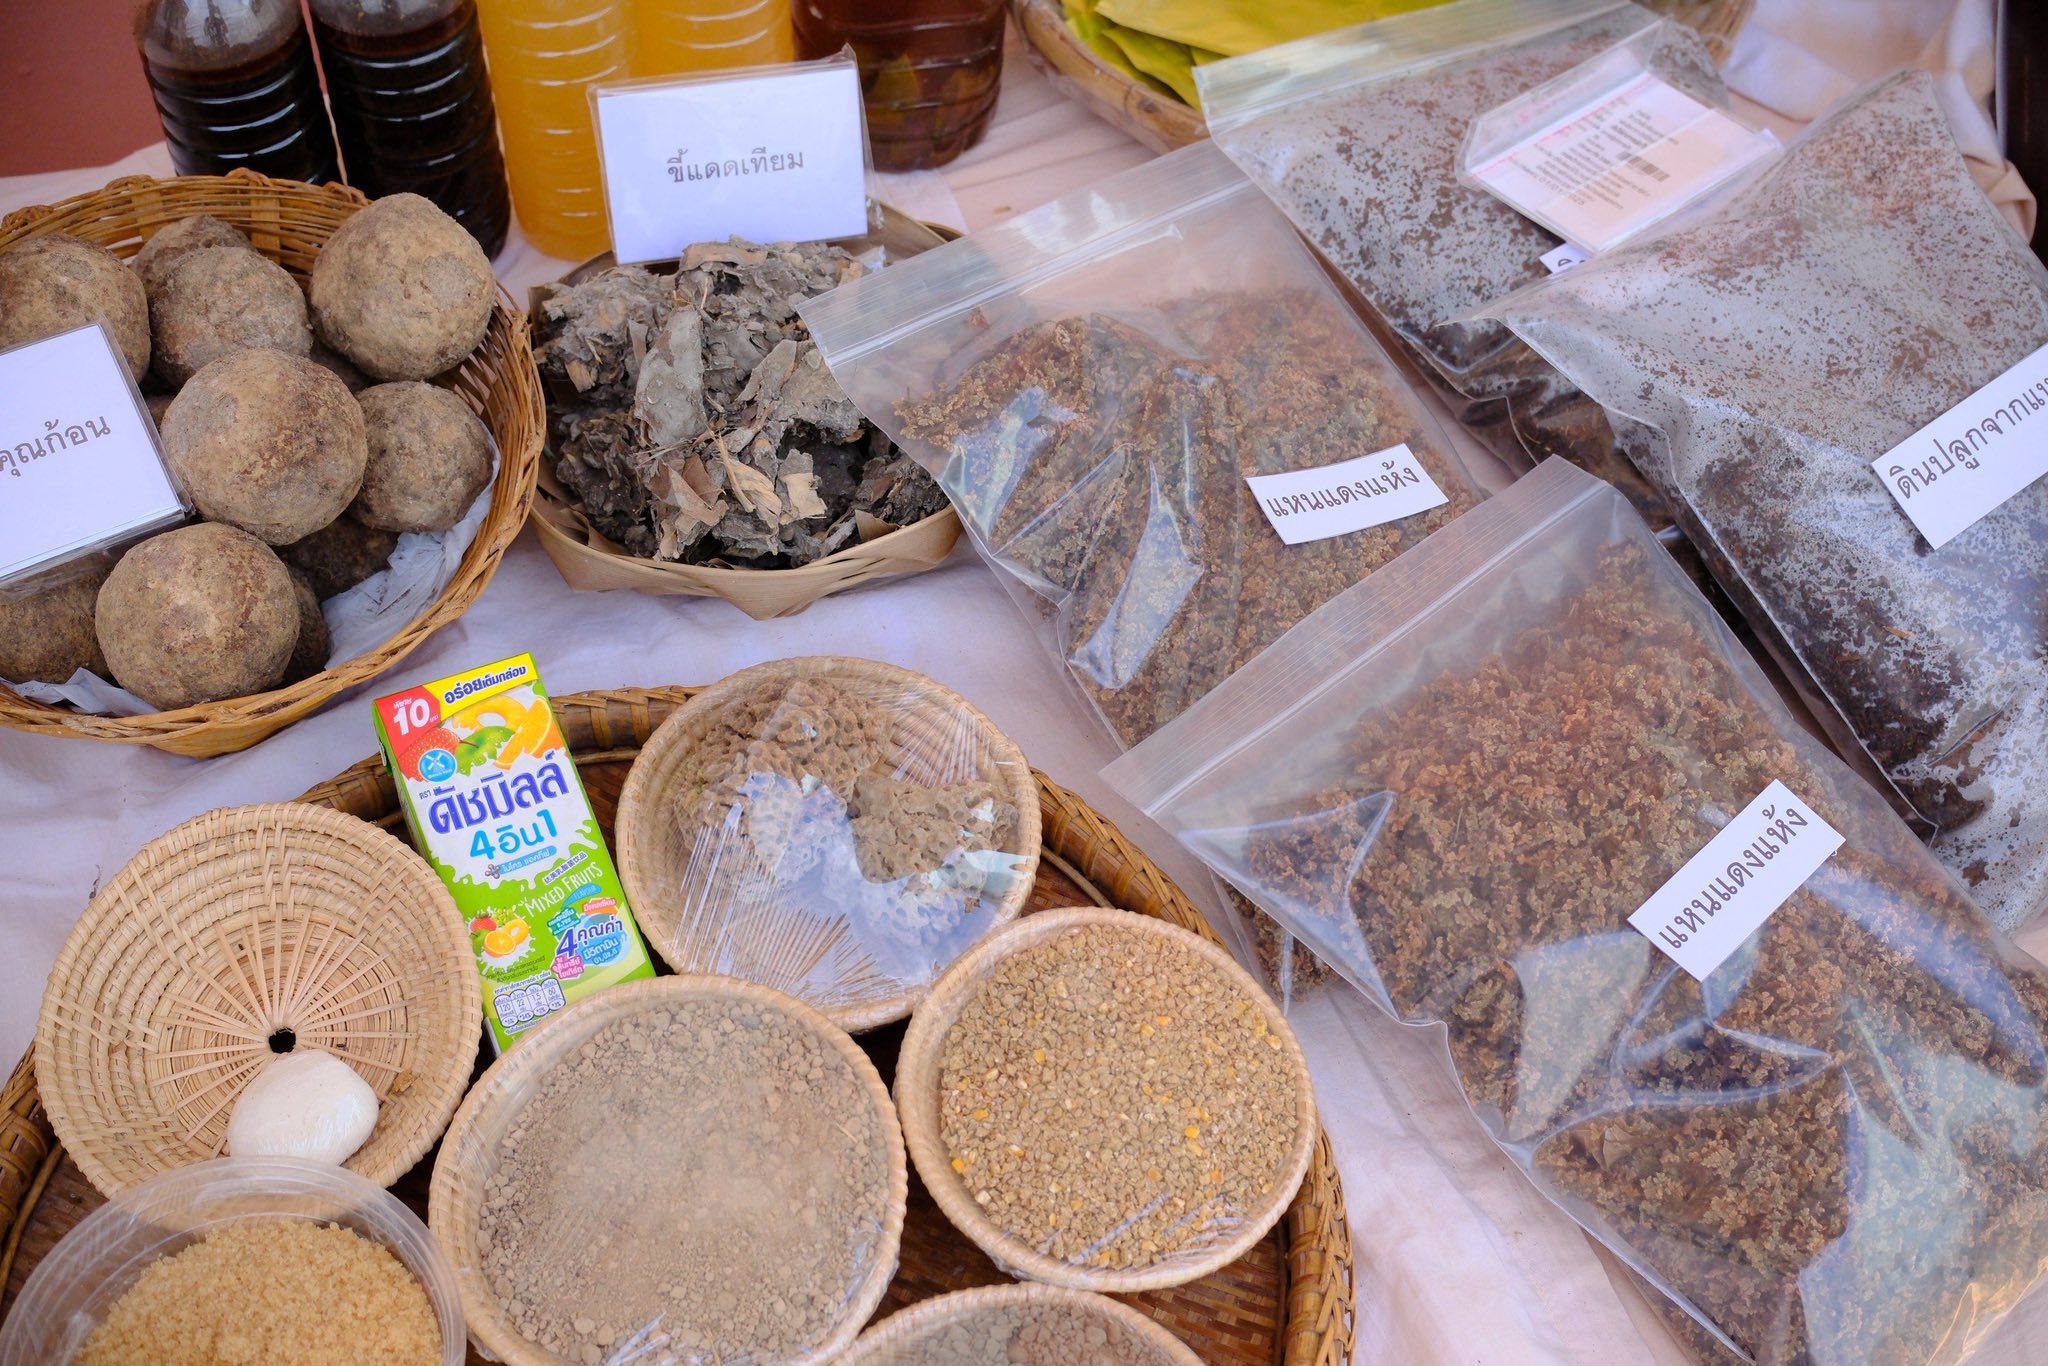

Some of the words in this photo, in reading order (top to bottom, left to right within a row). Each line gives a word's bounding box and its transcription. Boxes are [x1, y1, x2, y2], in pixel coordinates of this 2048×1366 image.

[666, 146, 805, 183] ขี้แดดเทียม
[1265, 460, 1421, 518] แหนแดงแห้ง
[444, 665, 527, 704] อร่อยเต็มกล่อง
[393, 698, 430, 736] 10
[419, 789, 431, 800] ตรา
[428, 750, 570, 834] ดัชมิลล์
[525, 886, 565, 917] MIXED
[561, 861, 603, 892] FRUITS
[1658, 803, 1809, 949] แหนแดงแห้ง
[577, 915, 623, 946] คุณค่า
[583, 938, 619, 960] มีวิตามิน
